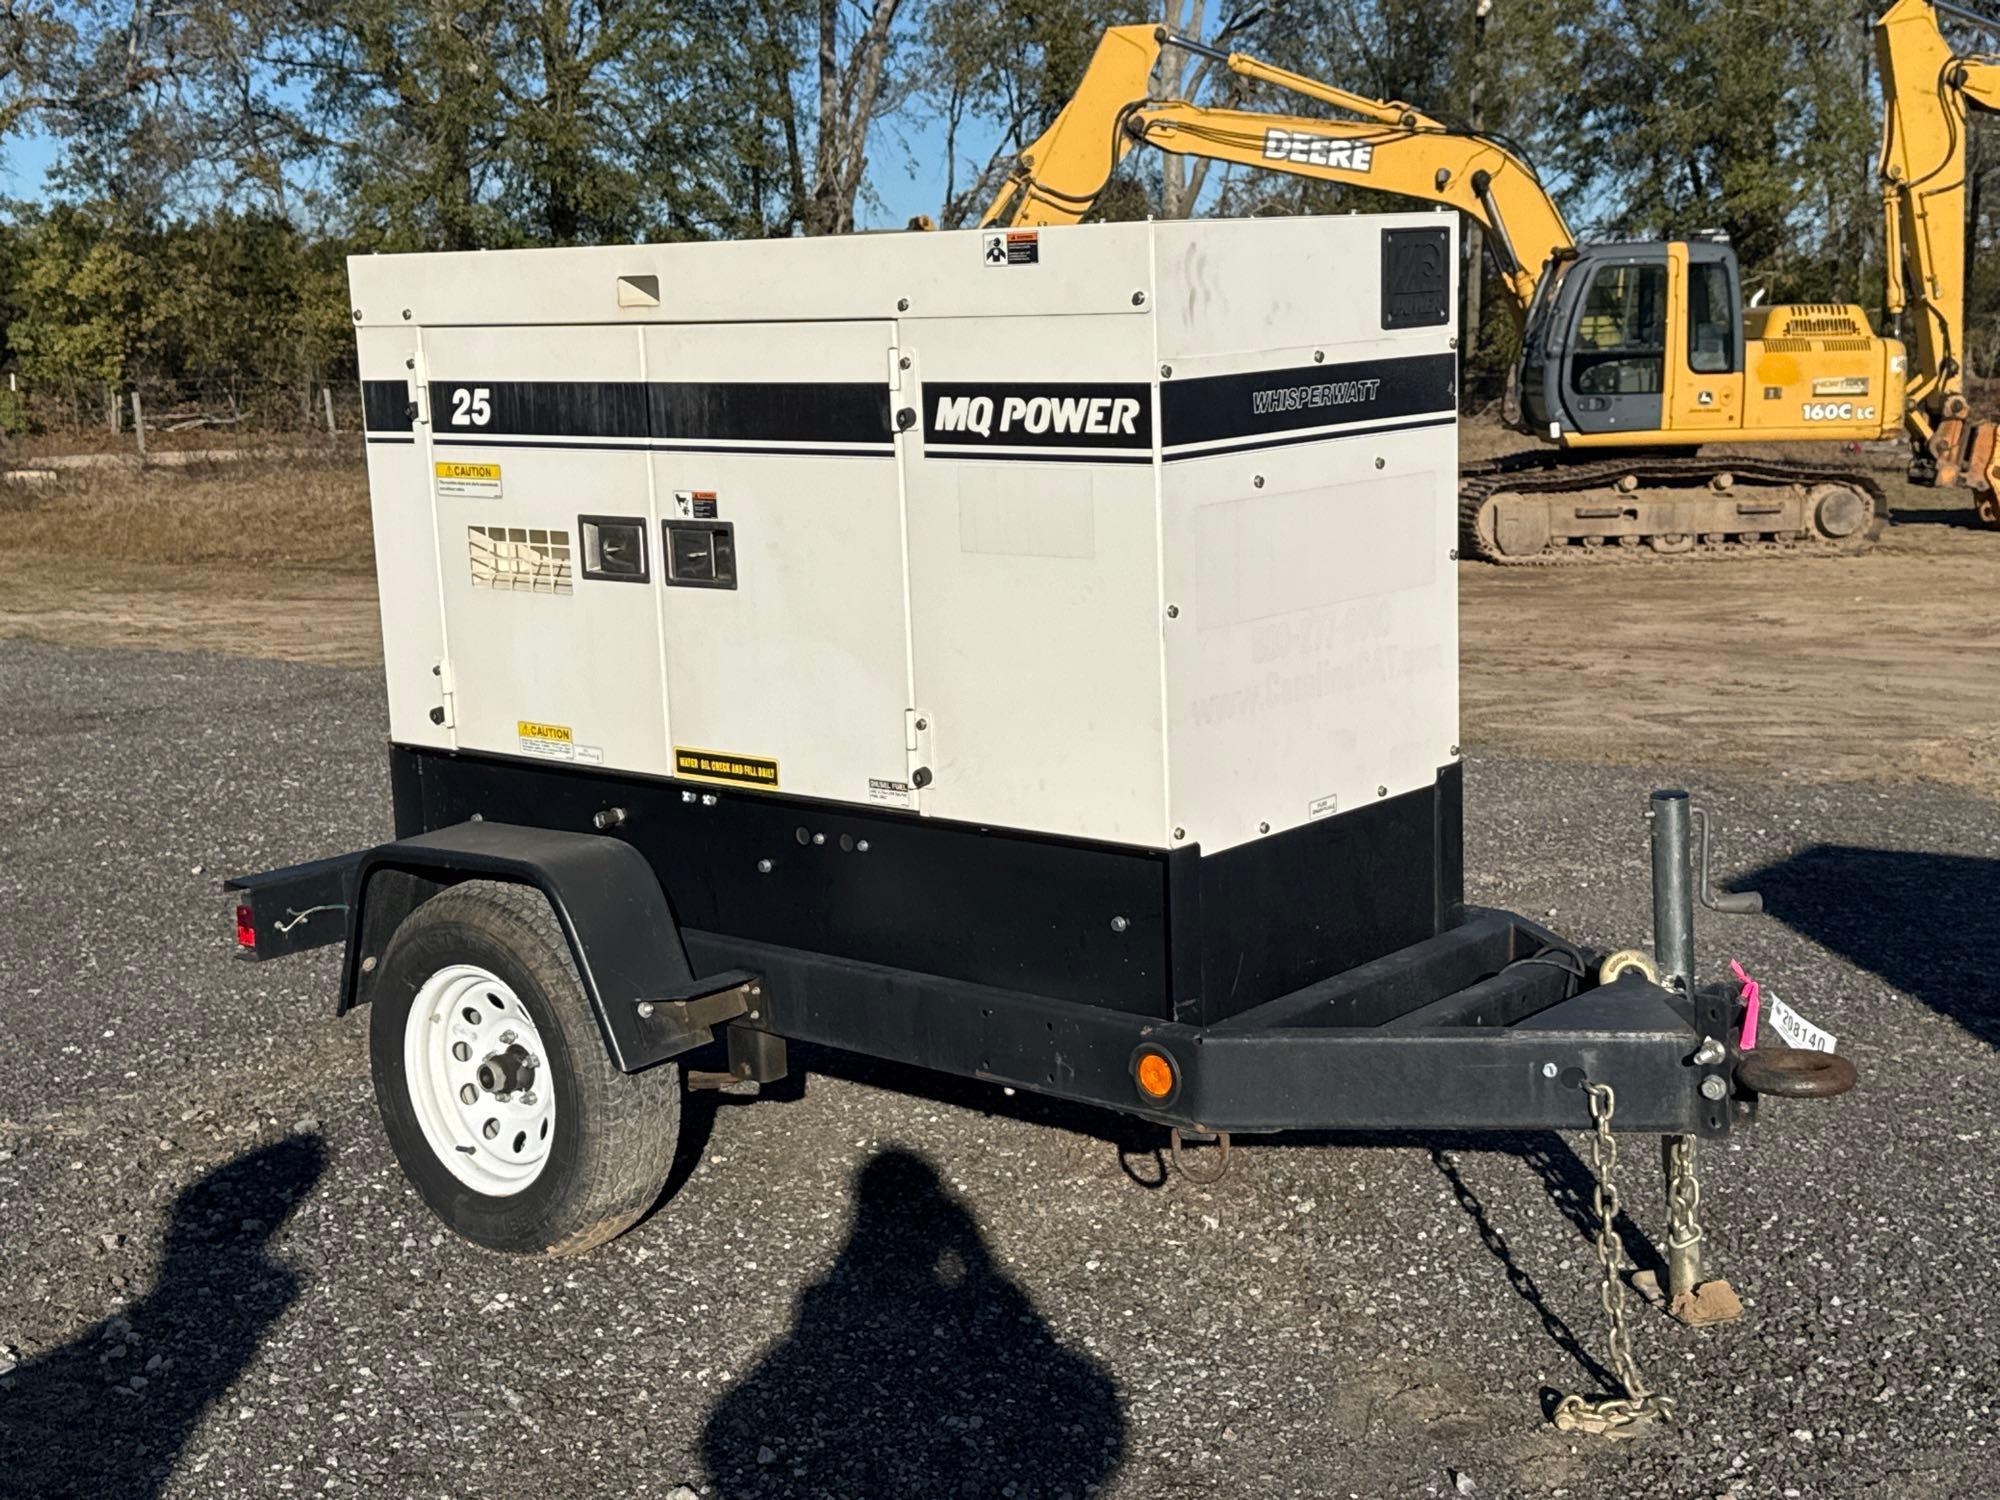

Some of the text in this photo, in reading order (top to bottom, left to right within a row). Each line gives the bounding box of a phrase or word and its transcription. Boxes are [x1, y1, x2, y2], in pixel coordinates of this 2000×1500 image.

[1263, 127, 1375, 173] DEERE
[451, 388, 491, 426] 25
[1252, 379, 1381, 415] WHISPERWATT
[1802, 403, 1875, 421] 160C LC
[934, 396, 1141, 438] MQ POWER
[454, 465, 492, 478] CAUTION
[530, 726, 570, 740] CAUTION
[1782, 1009, 1825, 1052] 208140
